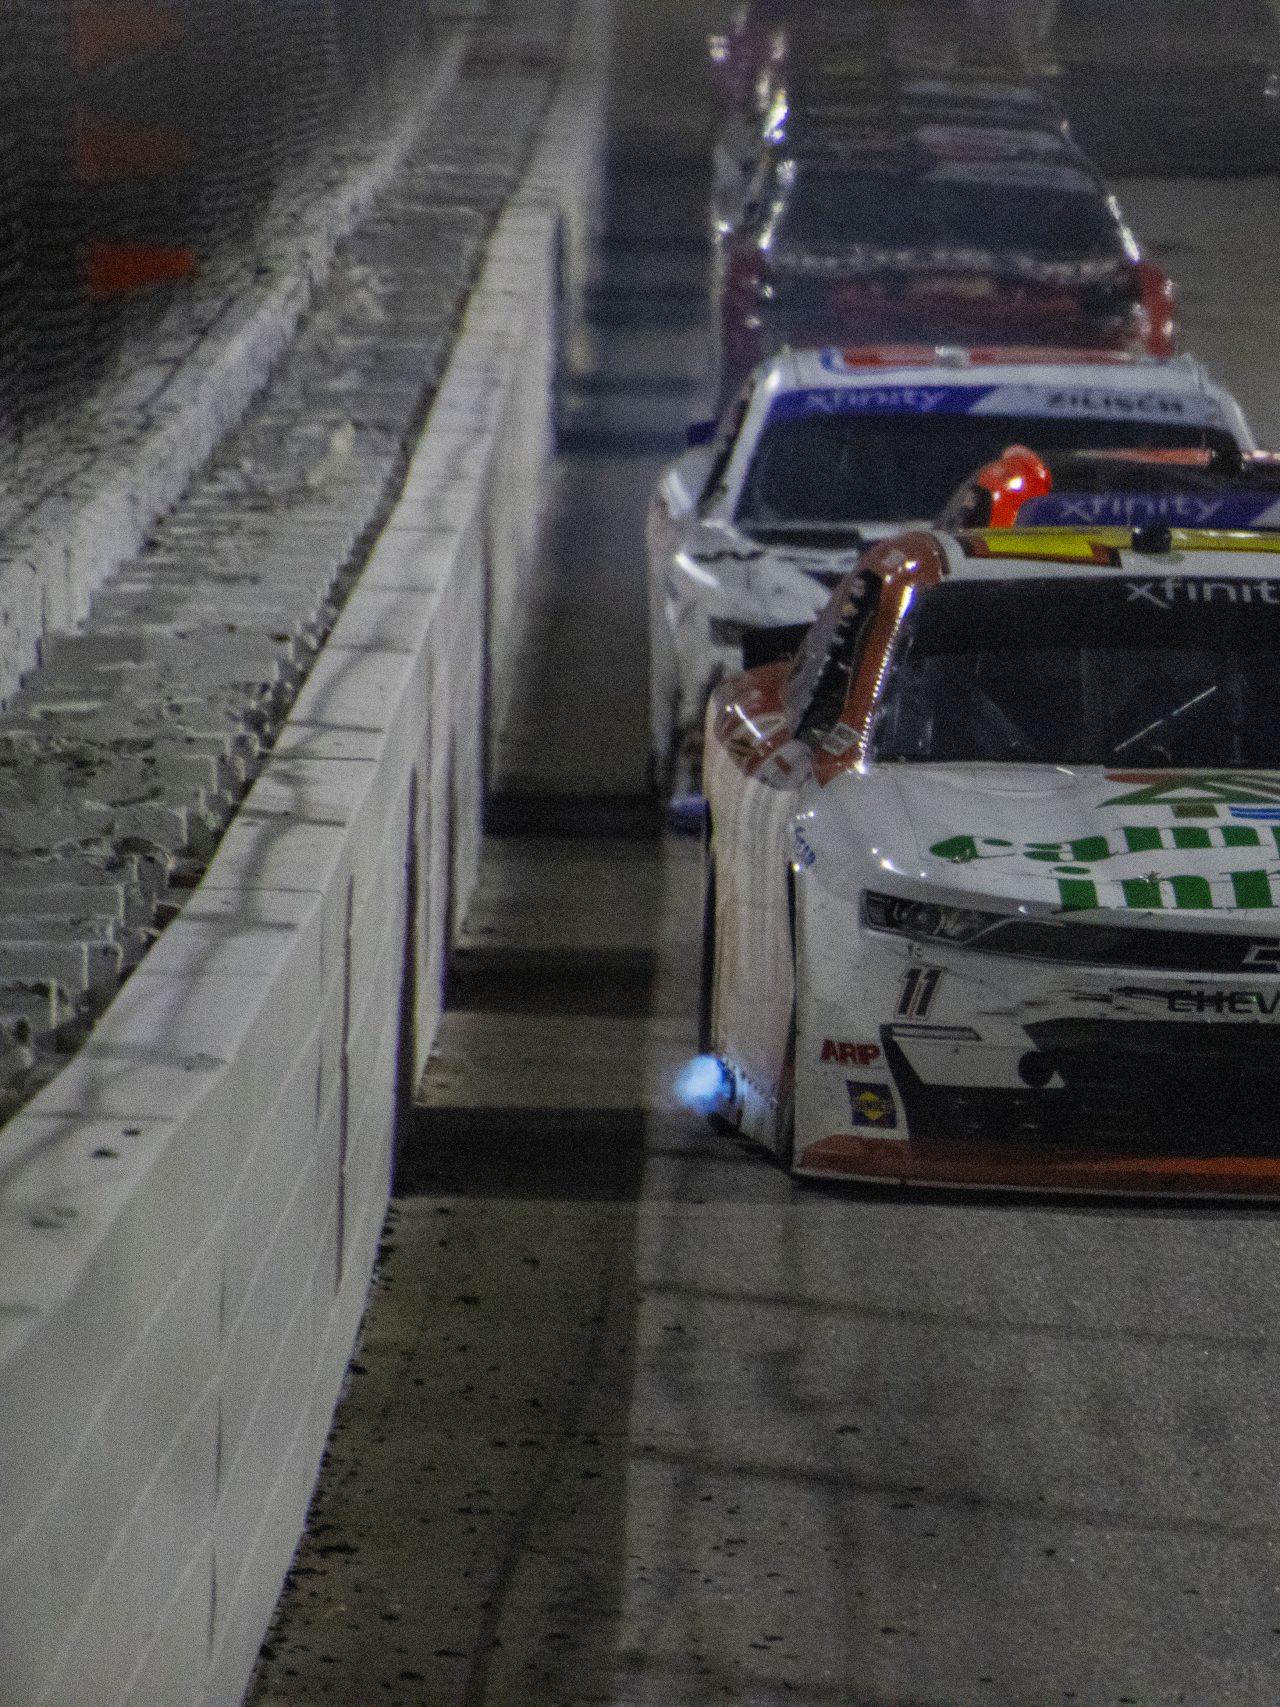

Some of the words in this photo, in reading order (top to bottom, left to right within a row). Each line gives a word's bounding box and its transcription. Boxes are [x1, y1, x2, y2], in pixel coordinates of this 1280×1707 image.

[1063, 494, 1223, 522] xfinity
[898, 967, 943, 1015] 11
[820, 1040, 880, 1065] ARP
